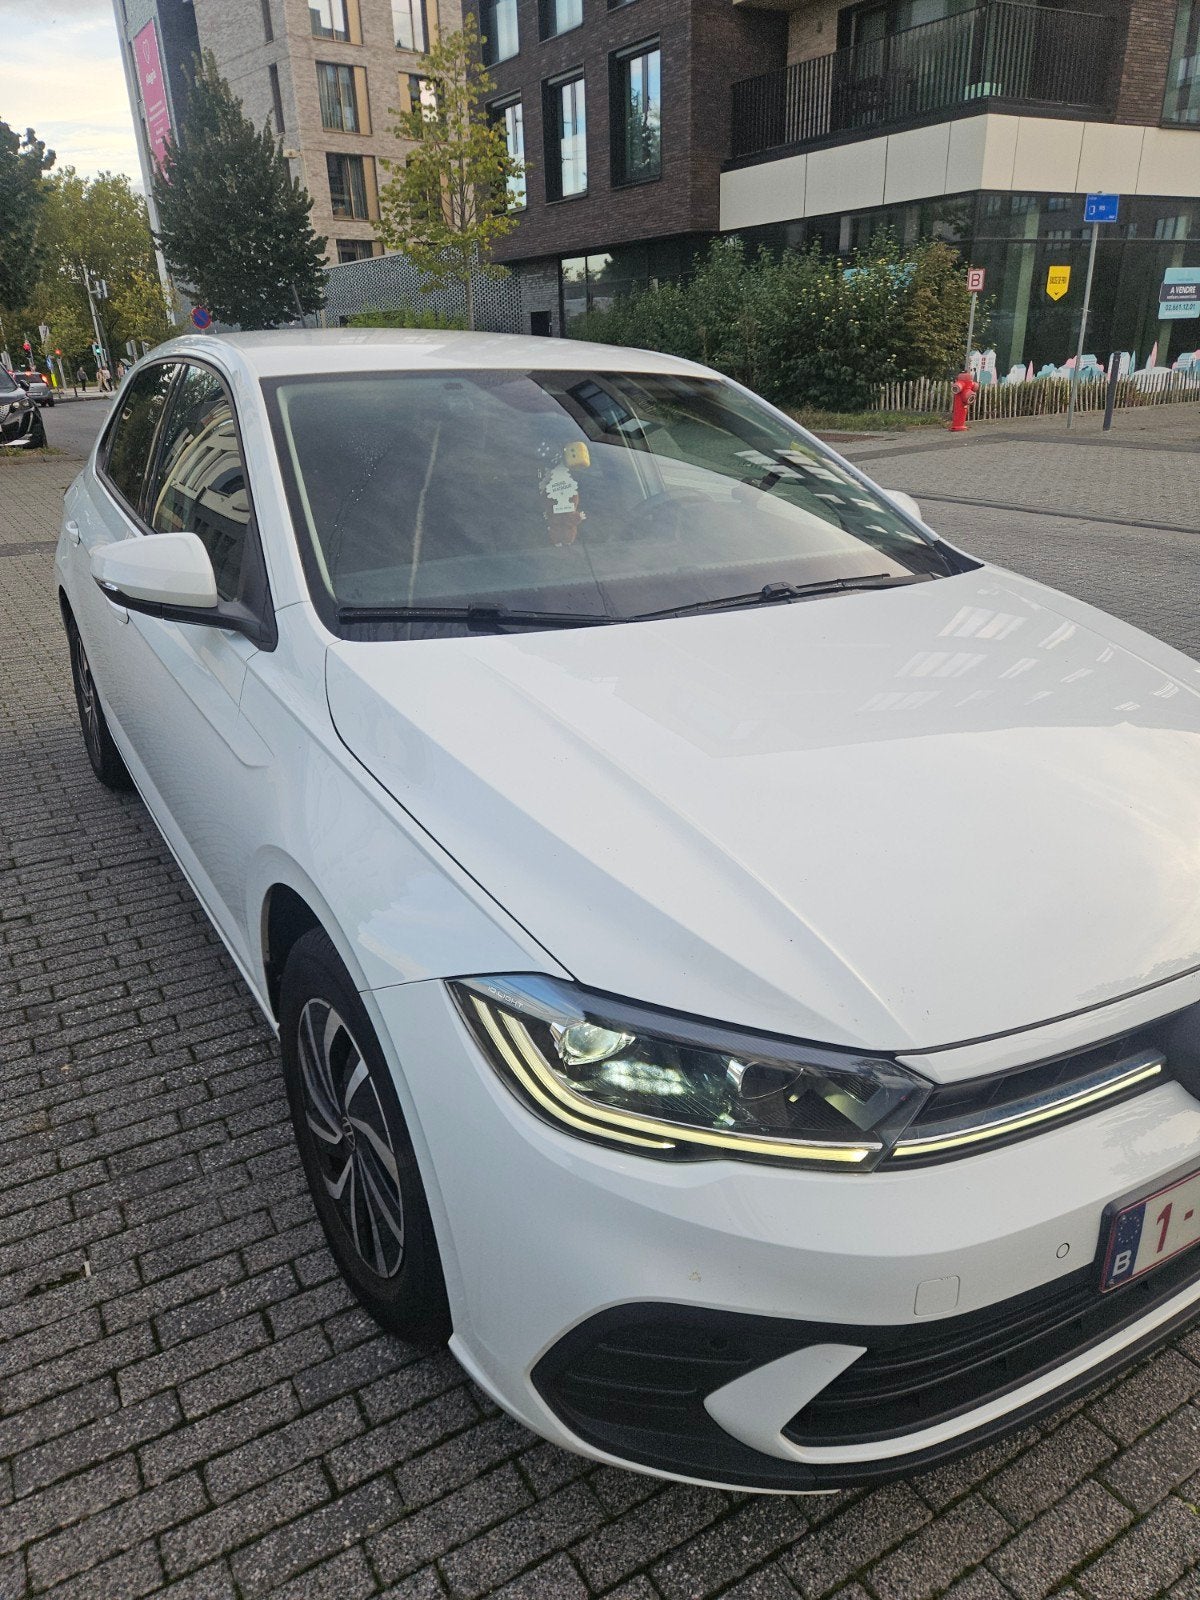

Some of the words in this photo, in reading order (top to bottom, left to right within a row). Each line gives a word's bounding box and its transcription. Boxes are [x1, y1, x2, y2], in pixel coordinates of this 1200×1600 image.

[971, 273, 981, 287] B
[1169, 286, 1175, 294] A
[1175, 285, 1197, 294] VENDRE
[487, 986, 525, 1009] IQ.LIGHT
[1112, 1250, 1132, 1277] B
